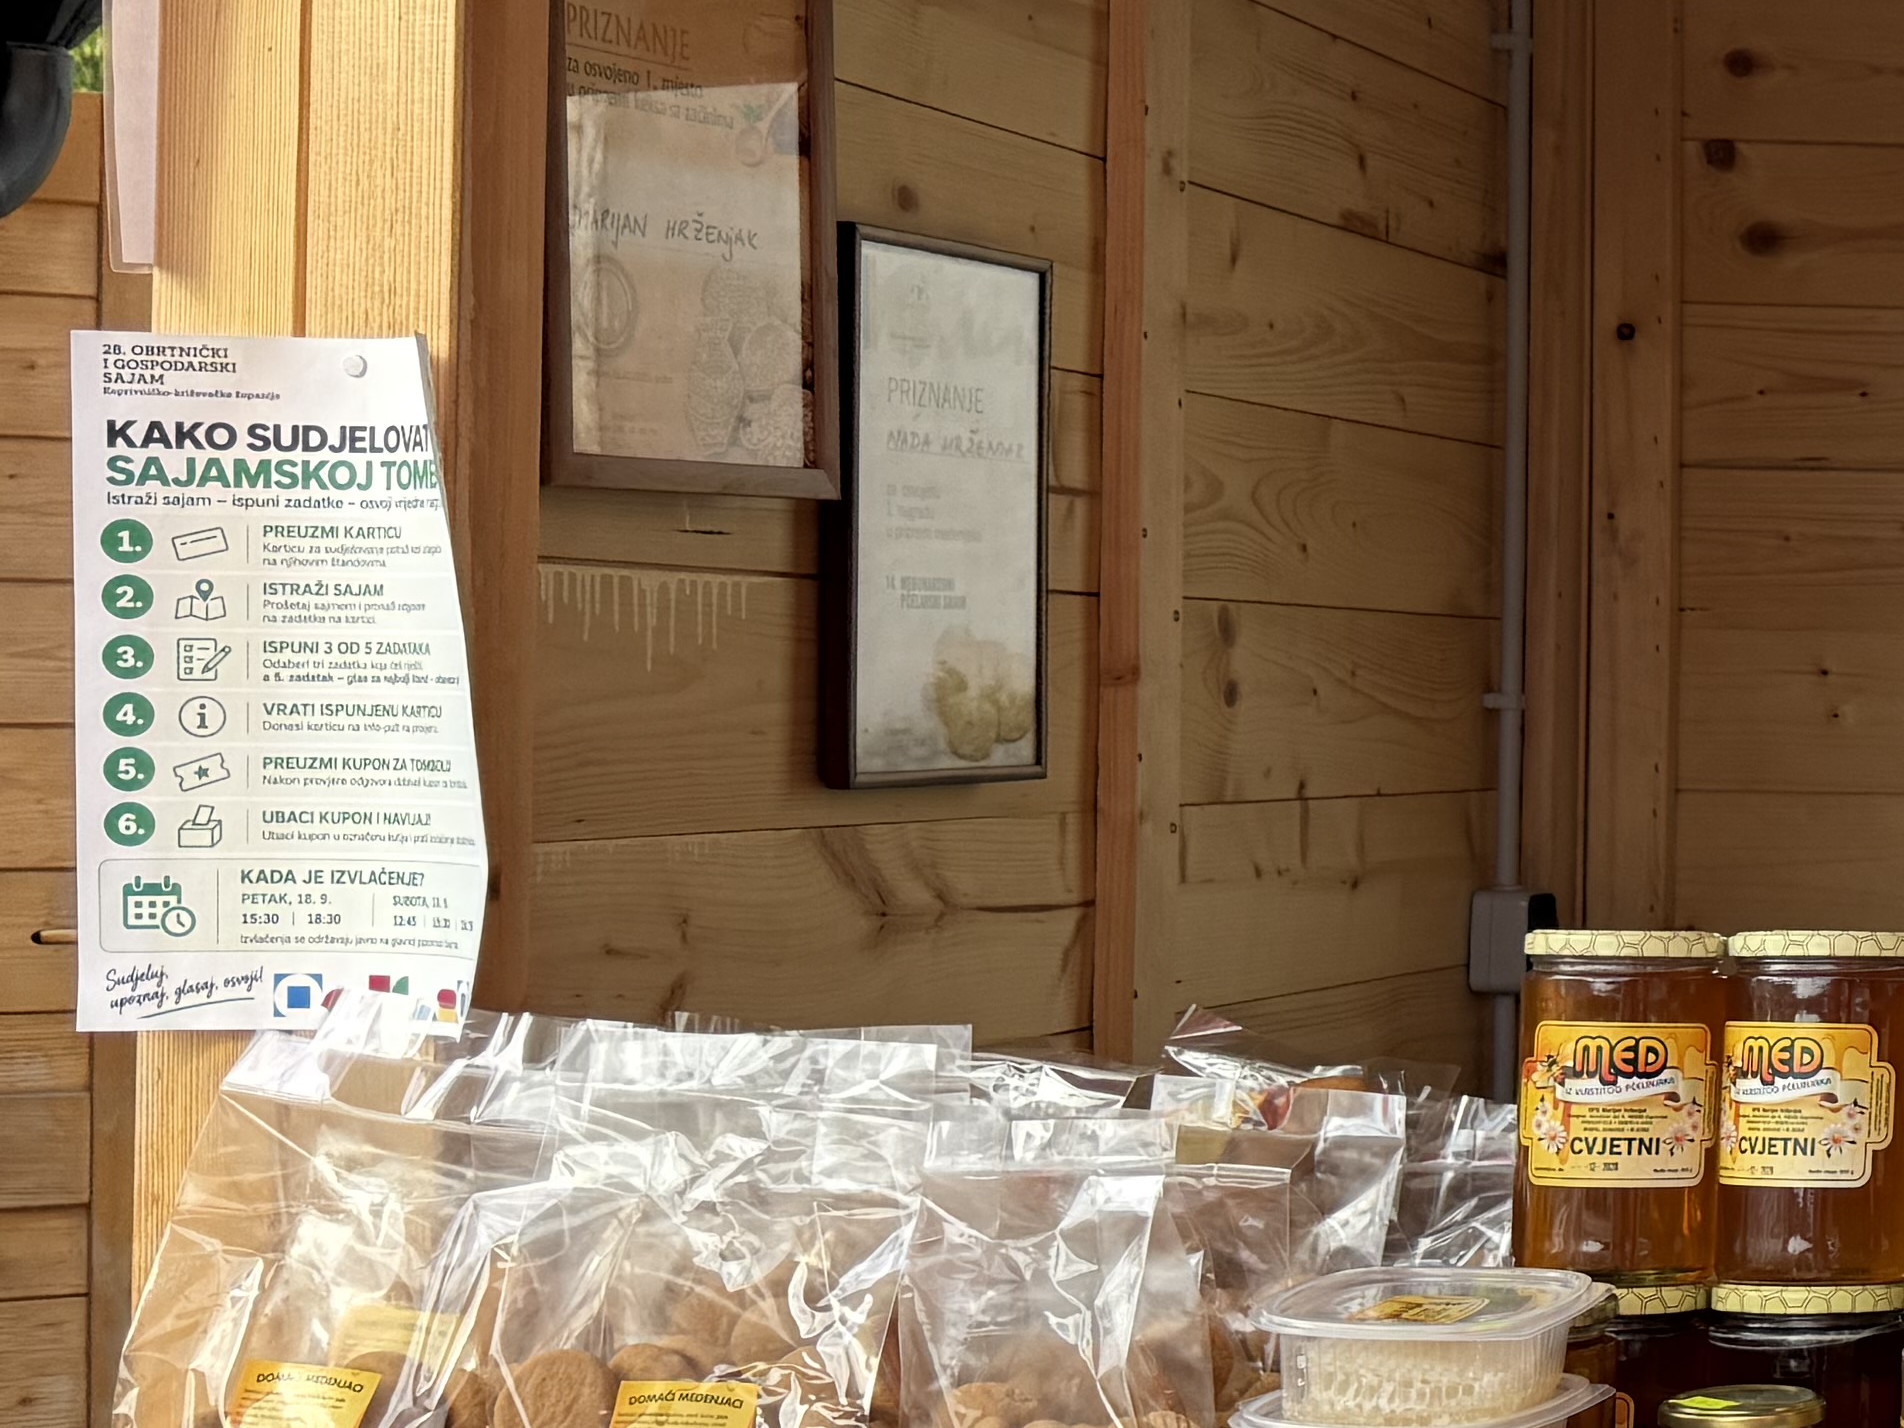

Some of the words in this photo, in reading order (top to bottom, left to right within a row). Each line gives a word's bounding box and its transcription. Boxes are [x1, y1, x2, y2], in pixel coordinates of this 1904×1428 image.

[567, 2, 690, 64] PRIZNANJE
[131, 344, 229, 359] OBRTNIČKI
[113, 359, 237, 373] GOSPODARSKI
[103, 373, 165, 385] SAJAM
[888, 376, 984, 414] PRIZNANJE
[106, 419, 238, 451] KAKO
[106, 454, 373, 491] SAJAMSKOJ
[106, 491, 158, 506] Istraži
[162, 494, 212, 508] sajam
[232, 494, 280, 510] ispuni
[284, 496, 344, 510] zadatke
[263, 525, 339, 539] PREUZMI
[344, 526, 402, 540] KARTICU
[263, 580, 329, 596] ISTRAŽI
[333, 583, 384, 597] SAJAM
[263, 640, 319, 654] ISPUNI
[323, 641, 334, 655] 3
[337, 642, 360, 655] OD
[364, 642, 373, 655] 5
[263, 702, 315, 717] VRATI
[319, 703, 399, 719] ISPUNJENU
[263, 756, 338, 770] PREUZMI
[342, 757, 391, 771] KUPON
[262, 810, 315, 824] UBACI
[319, 811, 373, 825] KUPON
[240, 869, 297, 884] KADA
[302, 869, 325, 884] JE
[330, 866, 425, 887] IZVLAČENJE?
[241, 893, 293, 906] PETAK,
[297, 893, 316, 905] 18.
[320, 894, 333, 905] 9.
[241, 913, 280, 925] 15:30
[307, 913, 342, 925] 18:30
[1573, 1036, 1668, 1085] MED
[1741, 1036, 1824, 1085] MED
[1570, 1136, 1661, 1156] CVJETNI
[1739, 1136, 1816, 1156] CVJETNI
[628, 1388, 675, 1407] DOMAĆI
[677, 1391, 744, 1410] MEDENJACI
